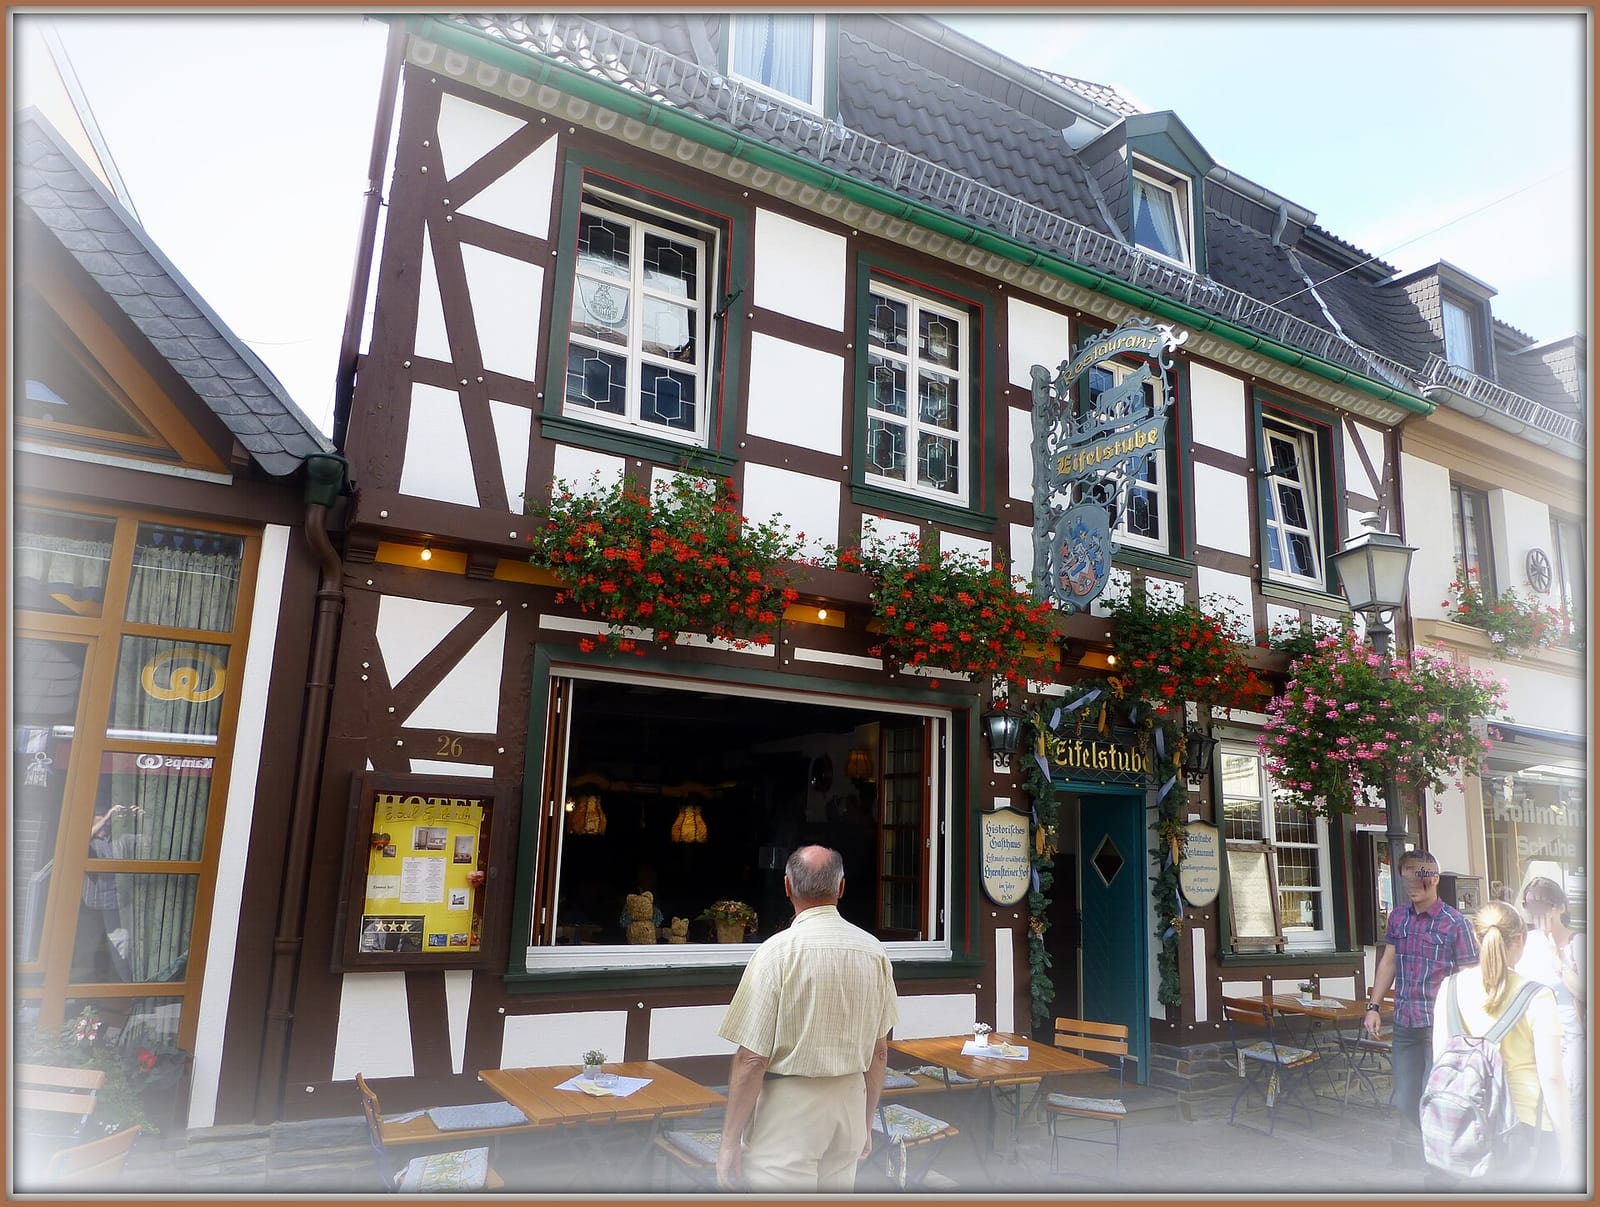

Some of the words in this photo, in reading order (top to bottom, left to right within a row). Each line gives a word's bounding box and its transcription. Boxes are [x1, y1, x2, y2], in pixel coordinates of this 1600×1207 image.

[1063, 335, 1158, 385] Restaurant
[1057, 428, 1158, 475] Eifelstube
[436, 735, 463, 758] 26
[377, 793, 485, 820] HOTEL
[1517, 834, 1577, 857] Schuhe
